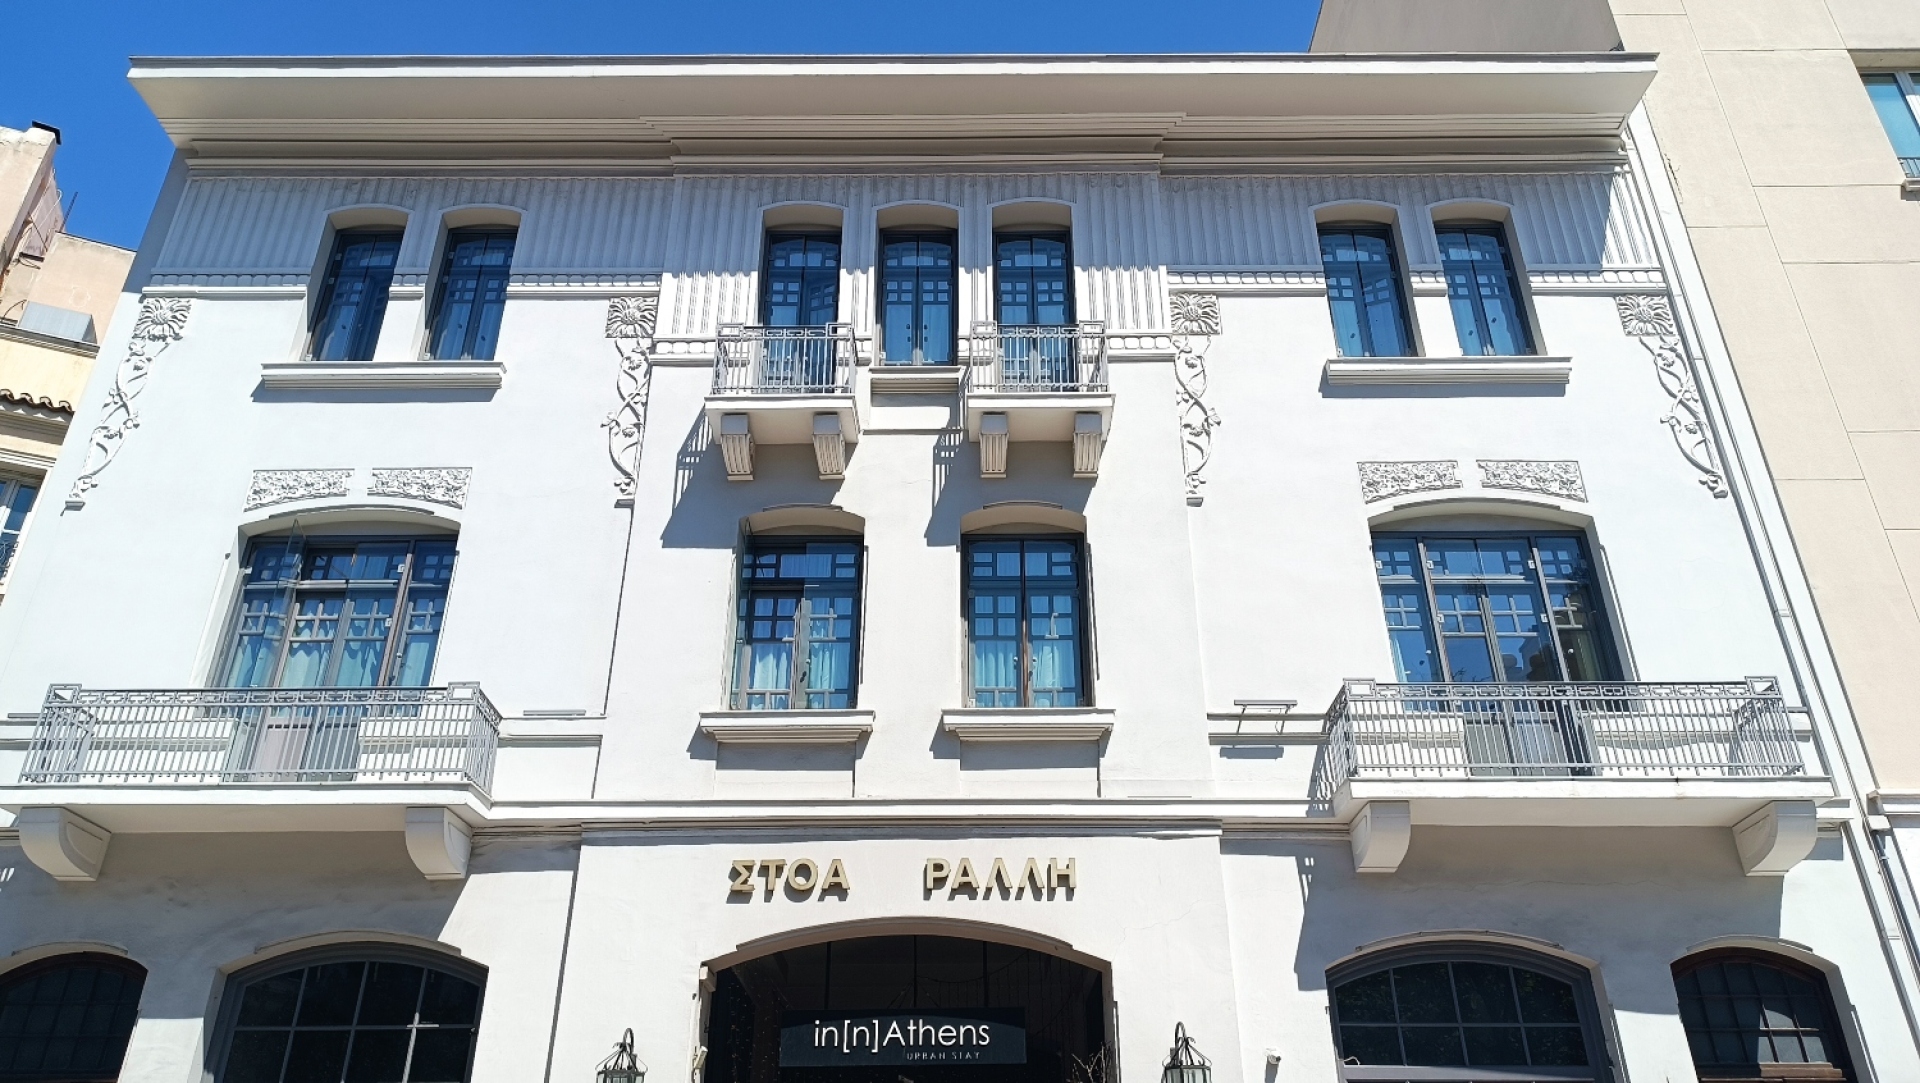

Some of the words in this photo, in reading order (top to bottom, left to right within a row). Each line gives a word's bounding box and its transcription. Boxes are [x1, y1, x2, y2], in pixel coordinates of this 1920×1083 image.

[730, 858, 851, 892] ΣΤΟΑ
[926, 857, 1077, 890] ΡΑΛΛΗ
[814, 1019, 990, 1052] in[n]Athens
[906, 1052, 947, 1060] URBAN
[952, 1052, 981, 1060] STAY
